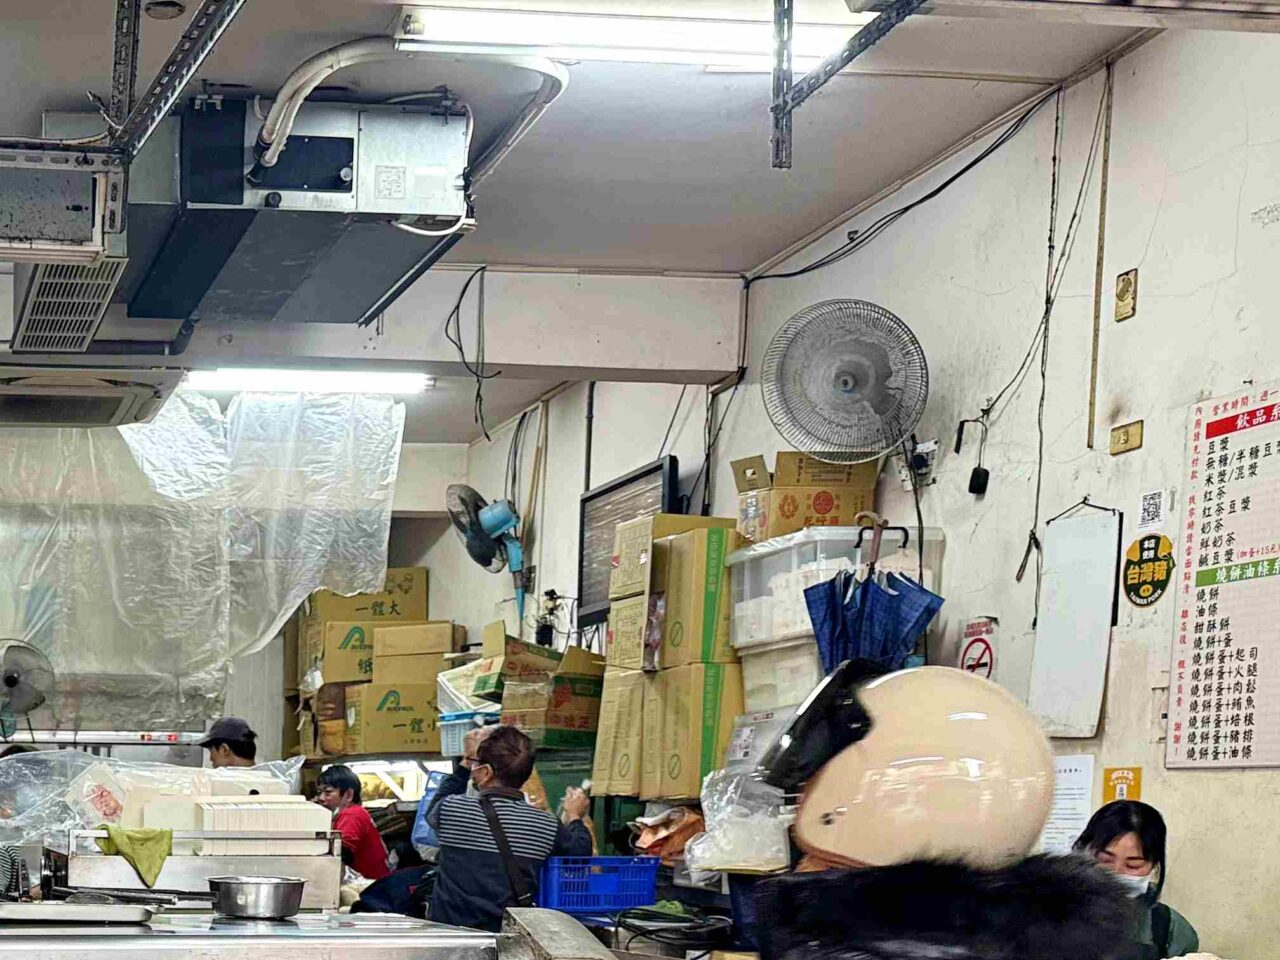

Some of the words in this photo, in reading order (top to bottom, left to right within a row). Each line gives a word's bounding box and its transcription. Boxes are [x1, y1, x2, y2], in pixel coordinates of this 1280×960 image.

[1207, 437, 1229, 455] 豆漿
[1203, 486, 1226, 503] 紅茶
[1202, 496, 1251, 518] 紅茶豆漿
[1201, 518, 1224, 535] 奶茶
[1200, 532, 1236, 551] 鮮奶茶
[1127, 560, 1168, 584] 台灣豬
[1196, 586, 1219, 603] 燒餅
[1196, 602, 1218, 618] 油條
[1194, 616, 1230, 633] 甜酥餅
[1192, 632, 1234, 650] 燒餅+蛋
[1192, 646, 1258, 666] 燒餅蛋+起司
[1191, 663, 1258, 682] 燒餅蛋+火腿
[1190, 679, 1256, 697] 燒餅蛋+肉鬆
[1189, 695, 1255, 713] 燒餅蛋+鮪魚
[1188, 712, 1255, 729] 燒餅蛋+培根
[1187, 729, 1253, 745] 燒餅蛋+豬排
[1186, 745, 1252, 761] 燒餅蛋+油條
